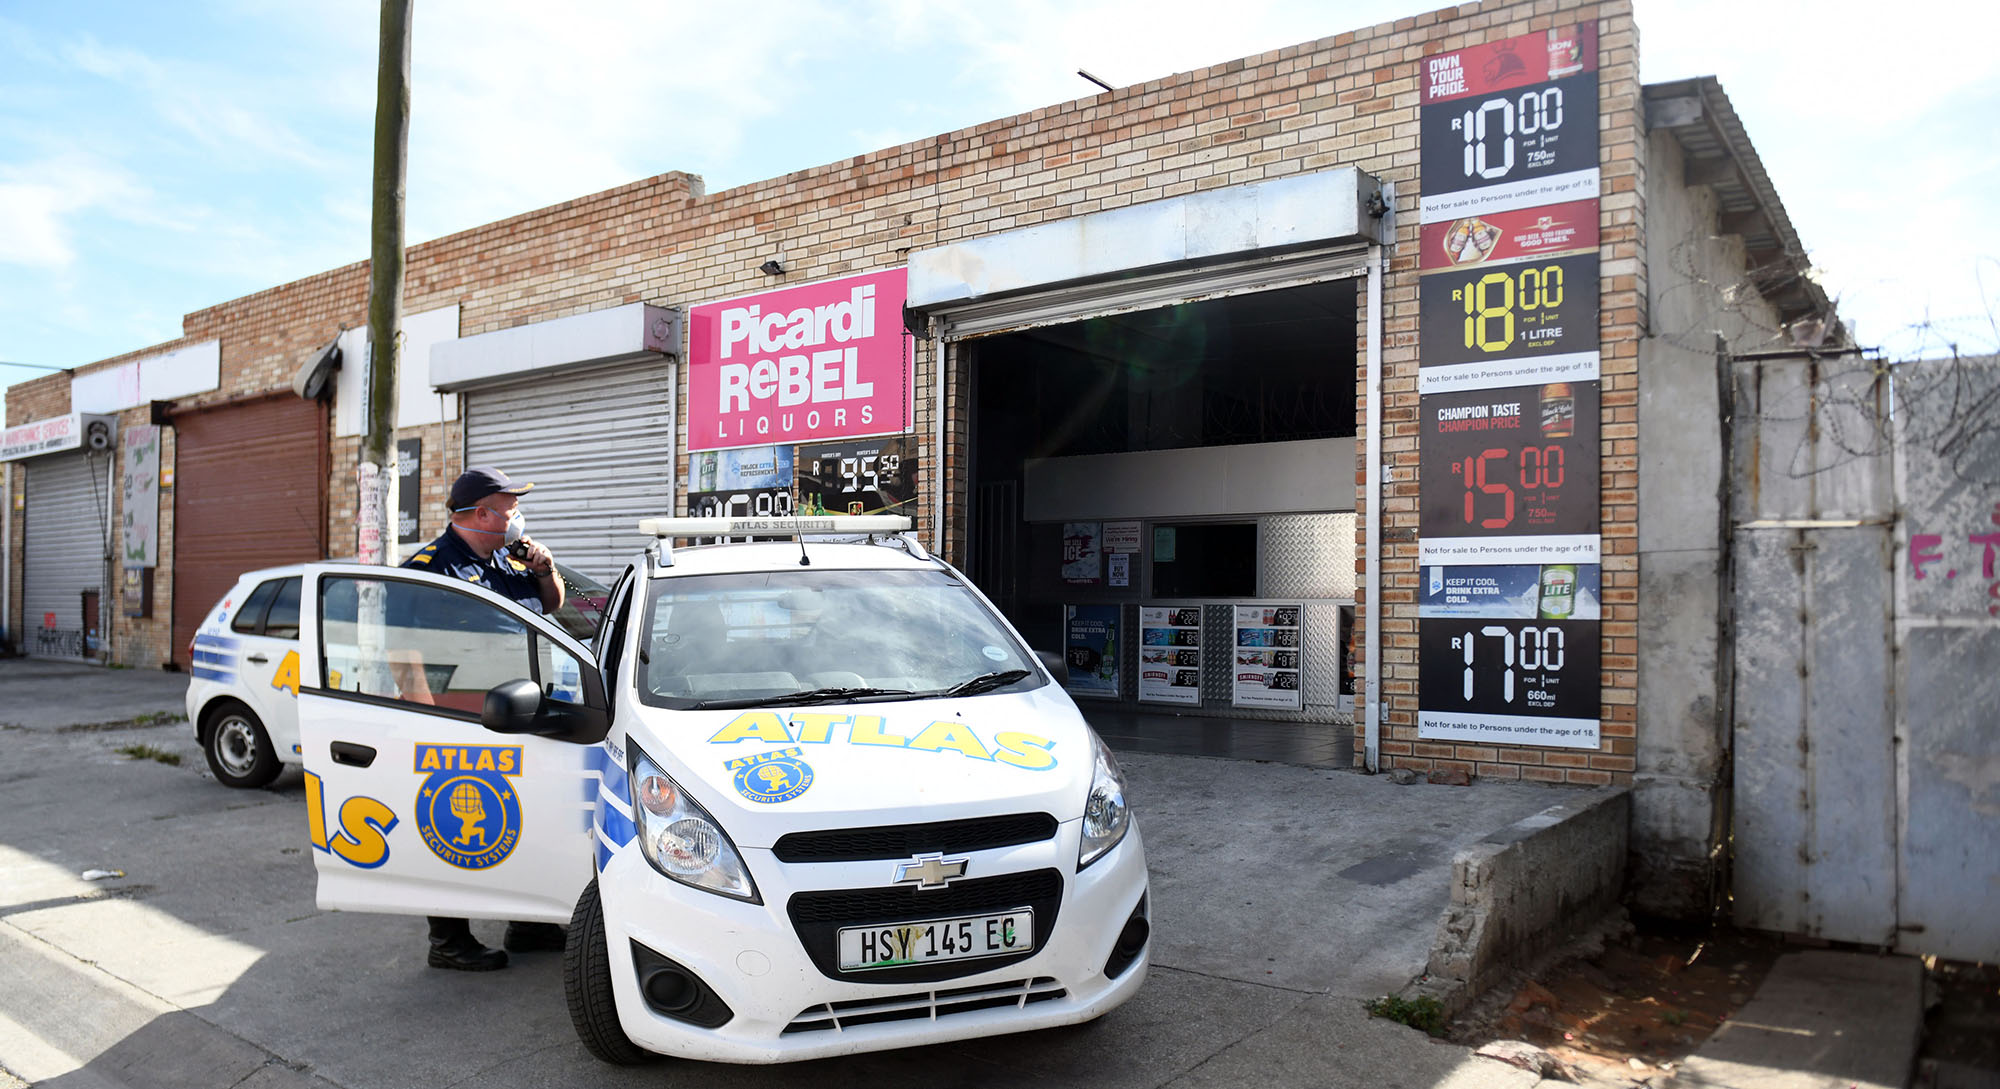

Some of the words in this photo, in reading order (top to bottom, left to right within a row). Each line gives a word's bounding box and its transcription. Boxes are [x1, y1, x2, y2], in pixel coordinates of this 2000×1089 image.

[1430, 55, 1460, 72] OWN
[1430, 67, 1464, 85] YOUR
[1429, 80, 1469, 98] PRIDE.
[1452, 118, 1462, 130] R
[1464, 98, 1514, 179] 10
[1519, 87, 1563, 134] 00
[1545, 135, 1559, 143] UNIT
[1453, 199, 1469, 208] sale
[1480, 193, 1513, 203] Persons
[1515, 189, 1538, 198] under
[1555, 184, 1570, 192] age
[1520, 239, 1542, 248] GOOD
[1452, 290, 1462, 301] R
[1464, 272, 1514, 352] 18
[1519, 265, 1563, 310] 00
[720, 284, 875, 359] Picardi
[1520, 331, 1527, 340] 1
[1529, 327, 1563, 340] LITRE
[1441, 374, 1452, 382] for
[1480, 370, 1513, 378] Persons
[1515, 367, 1538, 375] under
[1555, 365, 1570, 373] age
[1438, 405, 1489, 421] CHAMPION
[1492, 403, 1521, 417] TASTE
[719, 405, 873, 438] LIQUORS
[1438, 419, 1489, 433] CHAMPION
[1490, 416, 1521, 430] PRICE
[702, 463, 715, 475] LITE
[813, 460, 820, 476] R
[841, 457, 878, 493] 95
[881, 454, 899, 470] 50
[1452, 462, 1462, 475] R
[1464, 448, 1514, 528] 15
[1520, 445, 1564, 488] 00
[732, 521, 768, 530] ATLAS
[773, 520, 830, 530] SECURITY
[1064, 546, 1081, 561] ICE
[1446, 578, 1466, 586] KEEP
[1466, 578, 1474, 586] IT
[1446, 587, 1472, 595] DRINK
[1472, 587, 1500, 595] EXTRA
[1544, 584, 1570, 596] LITE
[1446, 595, 1470, 603] COLD.
[1451, 637, 1462, 649] R
[1464, 626, 1515, 703] 17
[1520, 626, 1564, 671] 00
[1527, 690, 1556, 701] 660ml
[1424, 720, 1438, 728] Not
[1480, 723, 1512, 732] Persons
[1540, 727, 1553, 735] the
[706, 711, 1058, 772] ATLAS
[420, 747, 516, 772] ATLAS
[730, 748, 799, 769] ATLAS
[741, 789, 784, 803] SECURITY
[785, 774, 812, 799] SYSTEMS
[421, 824, 471, 867] SECURITY
[475, 827, 517, 867] SYSTEMS
[861, 927, 911, 964] HSY
[925, 922, 972, 957] 145
[986, 917, 1016, 950] EC
